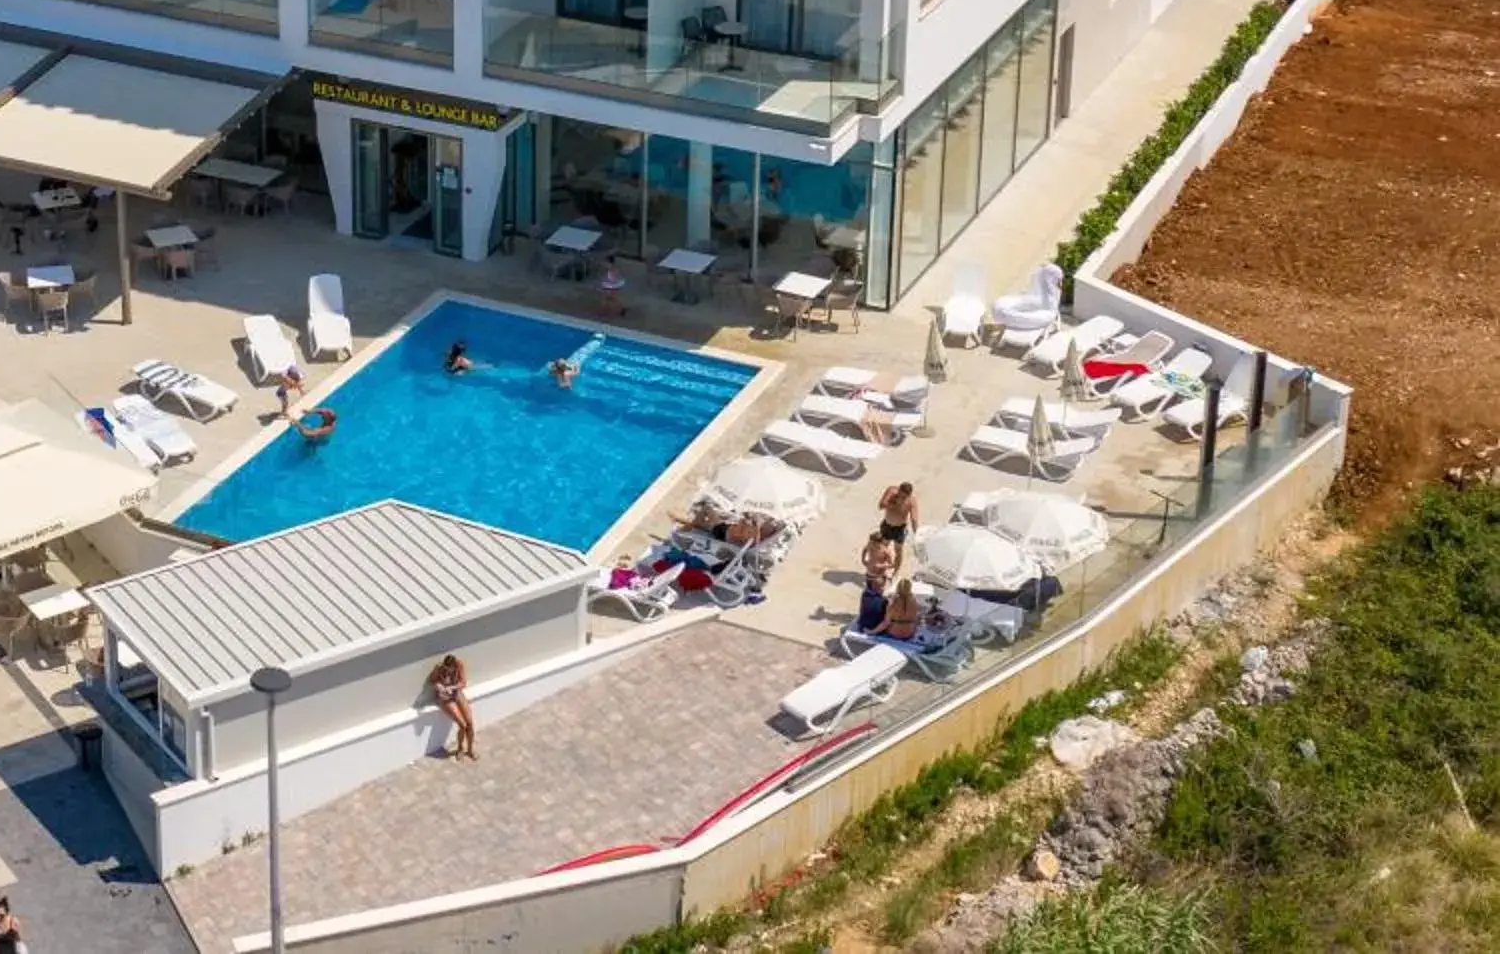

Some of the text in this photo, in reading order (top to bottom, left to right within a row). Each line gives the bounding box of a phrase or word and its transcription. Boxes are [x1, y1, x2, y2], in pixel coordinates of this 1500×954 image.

[313, 81, 397, 109] RESTAURANT
[415, 102, 465, 122] LOUNGE
[471, 110, 498, 130] BAR
